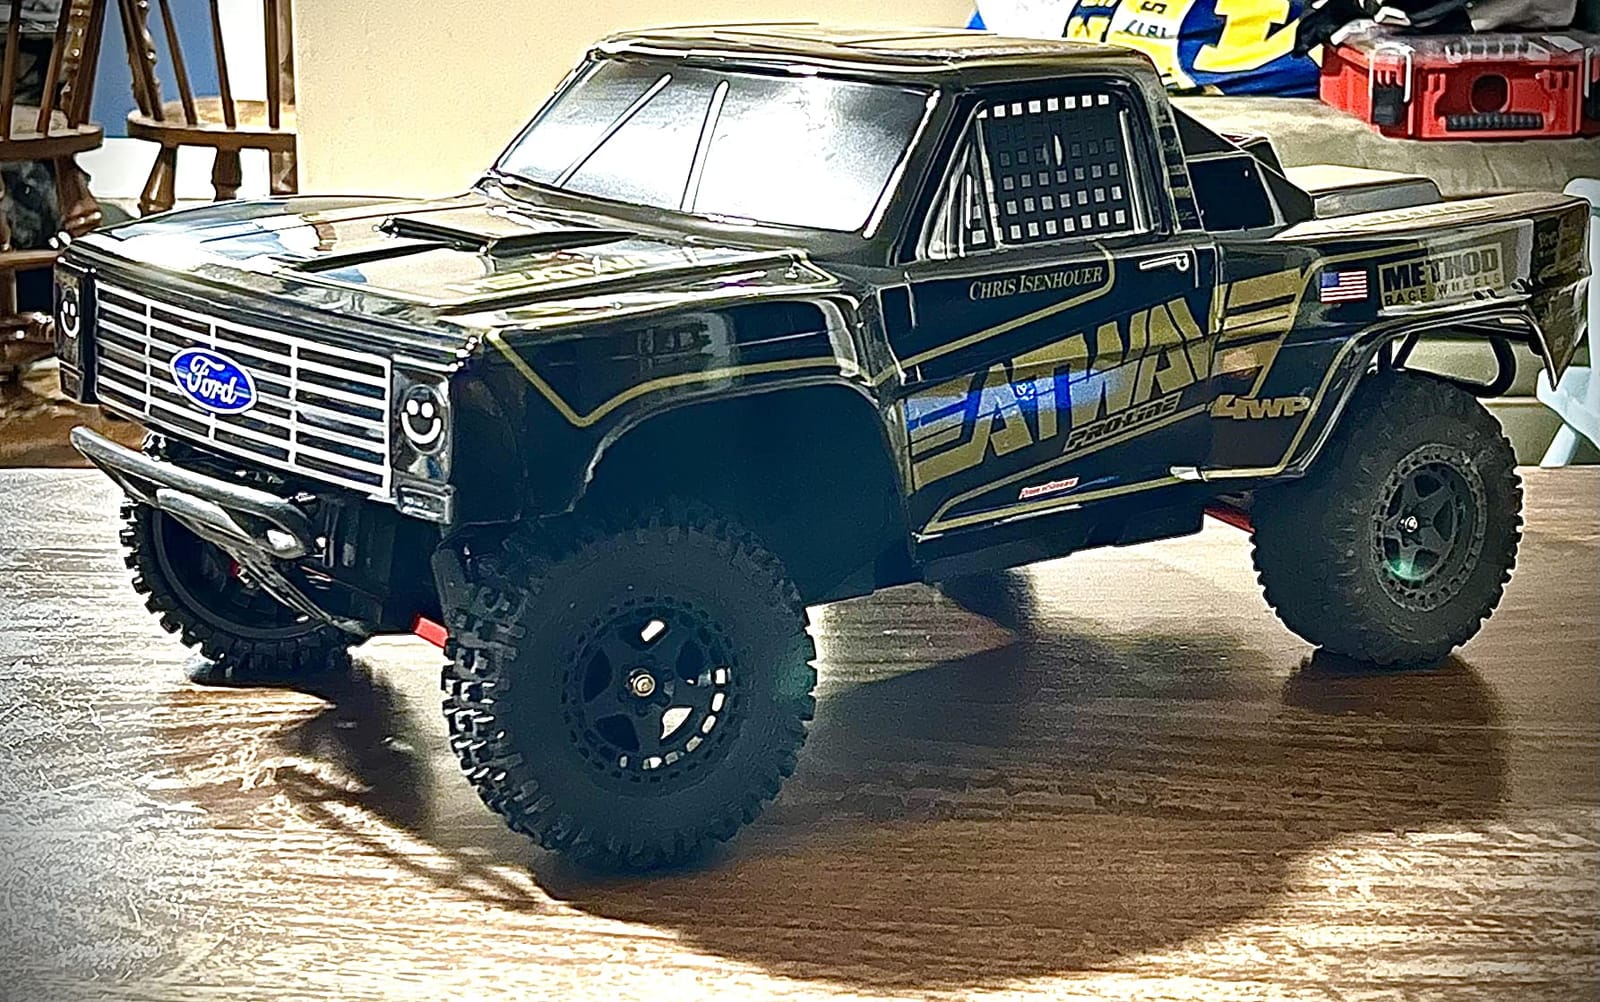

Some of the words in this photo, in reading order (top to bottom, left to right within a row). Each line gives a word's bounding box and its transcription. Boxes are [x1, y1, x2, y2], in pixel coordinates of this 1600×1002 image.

[1381, 247, 1500, 294] METHOD
[969, 278, 1017, 301] CHRIS
[1384, 288, 1428, 307] RACE
[1437, 273, 1502, 296] WHEELS
[185, 354, 238, 405] Ford
[1211, 393, 1312, 420] 4WP
